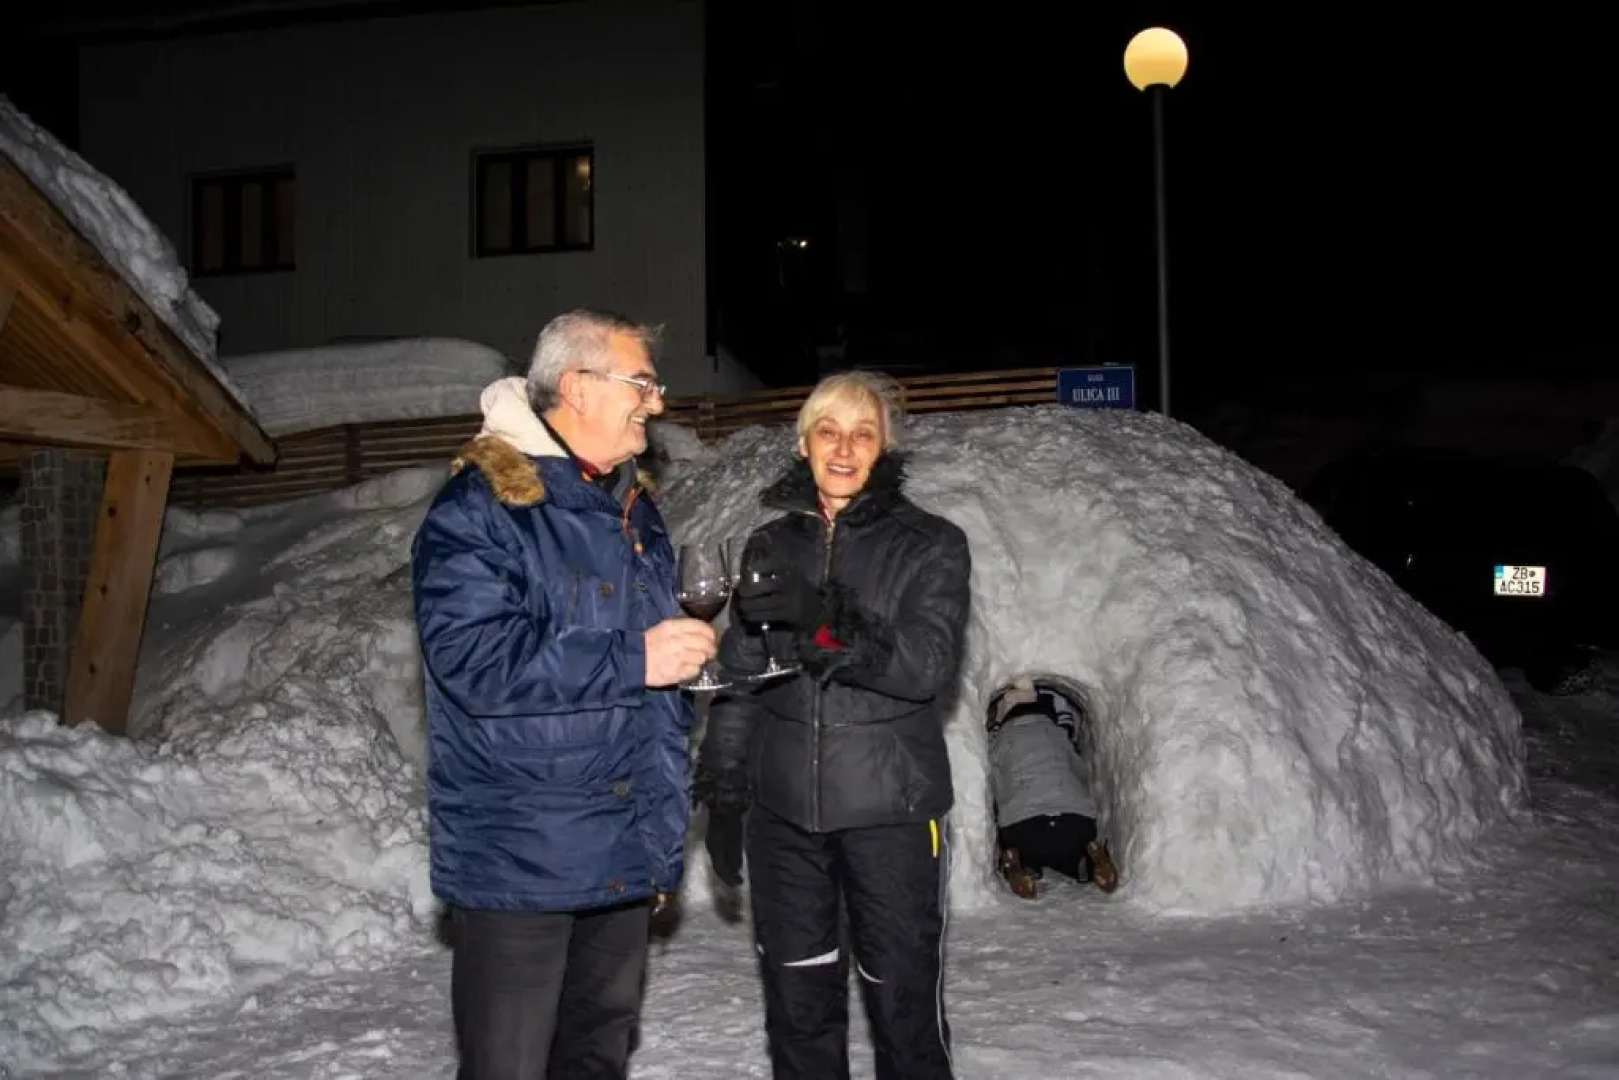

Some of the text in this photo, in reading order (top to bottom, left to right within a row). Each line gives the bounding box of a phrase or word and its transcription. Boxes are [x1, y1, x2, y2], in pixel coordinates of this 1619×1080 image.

[1072, 386, 1120, 402] ULICA III
[1500, 578, 1540, 593] AC315
